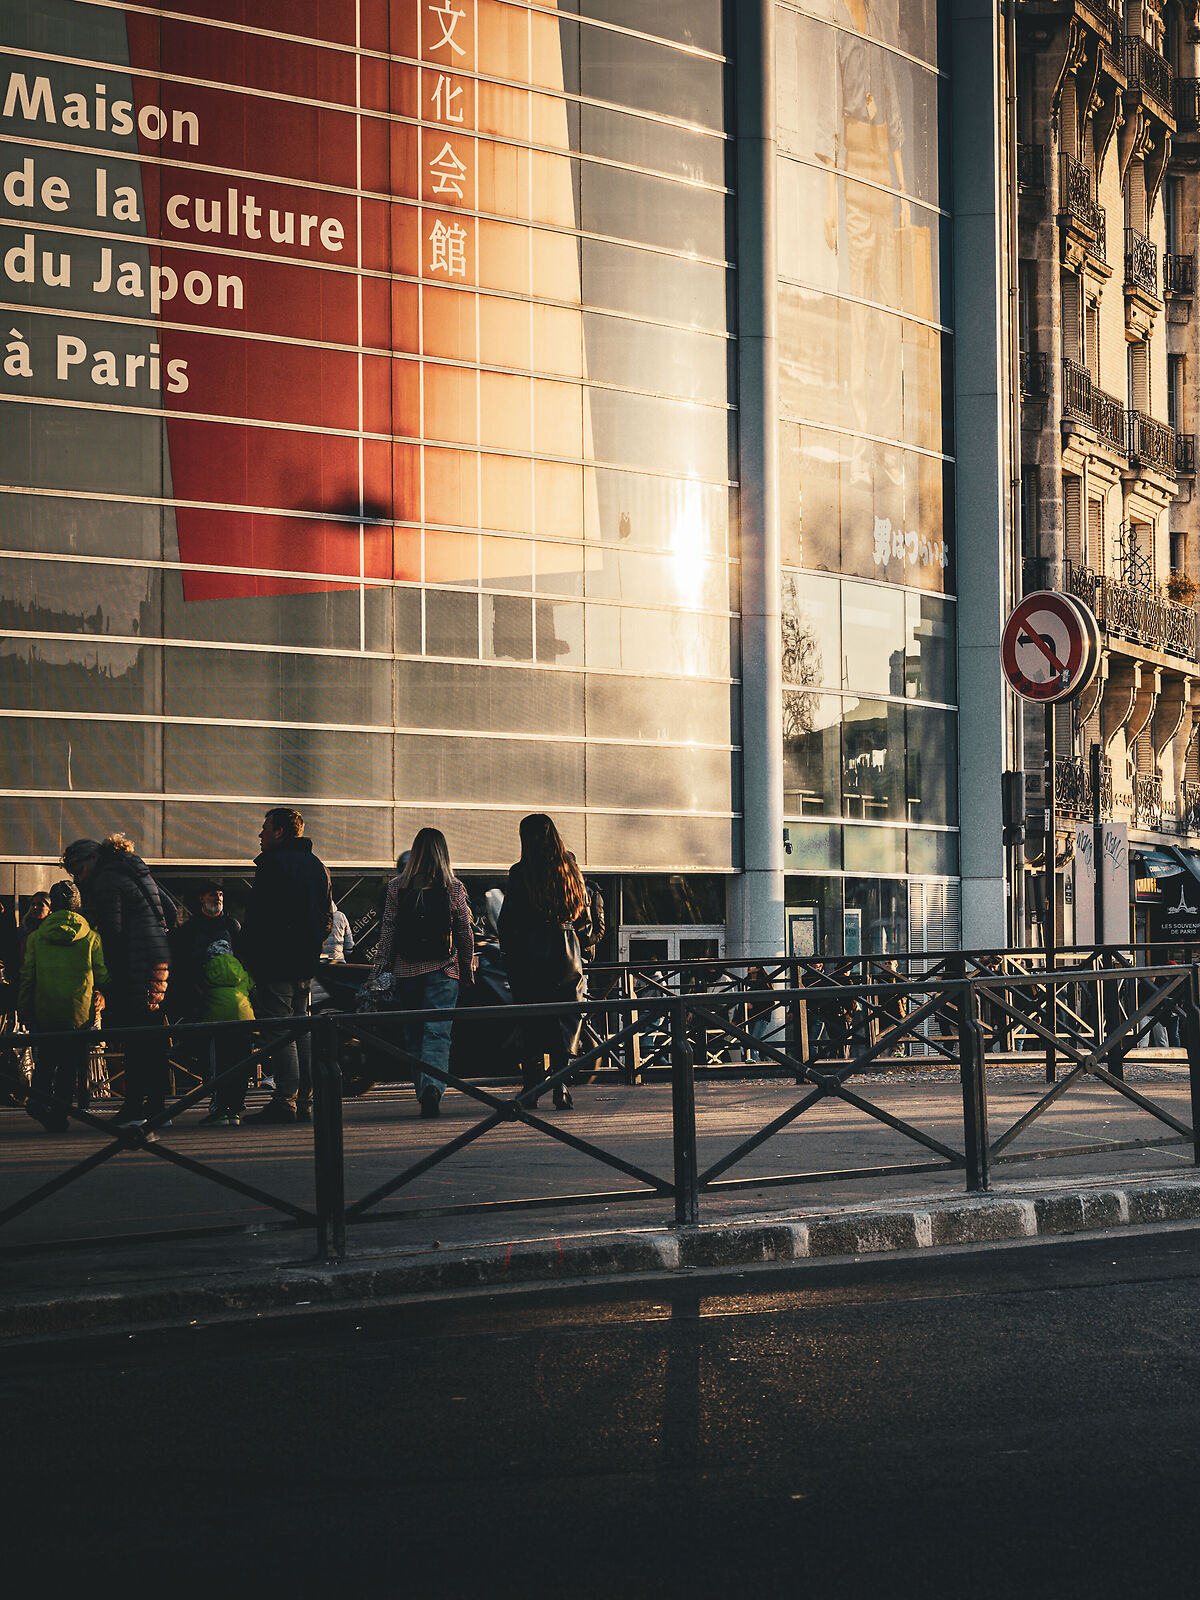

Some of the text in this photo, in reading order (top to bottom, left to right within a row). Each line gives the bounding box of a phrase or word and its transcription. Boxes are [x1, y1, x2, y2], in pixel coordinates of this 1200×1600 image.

[2, 72, 200, 147] Maison
[428, 0, 467, 277] 文化会館
[3, 157, 346, 252] de la culture
[4, 234, 244, 314] du Japon
[4, 328, 190, 394] à Paris
[351, 909, 377, 937] eliers
